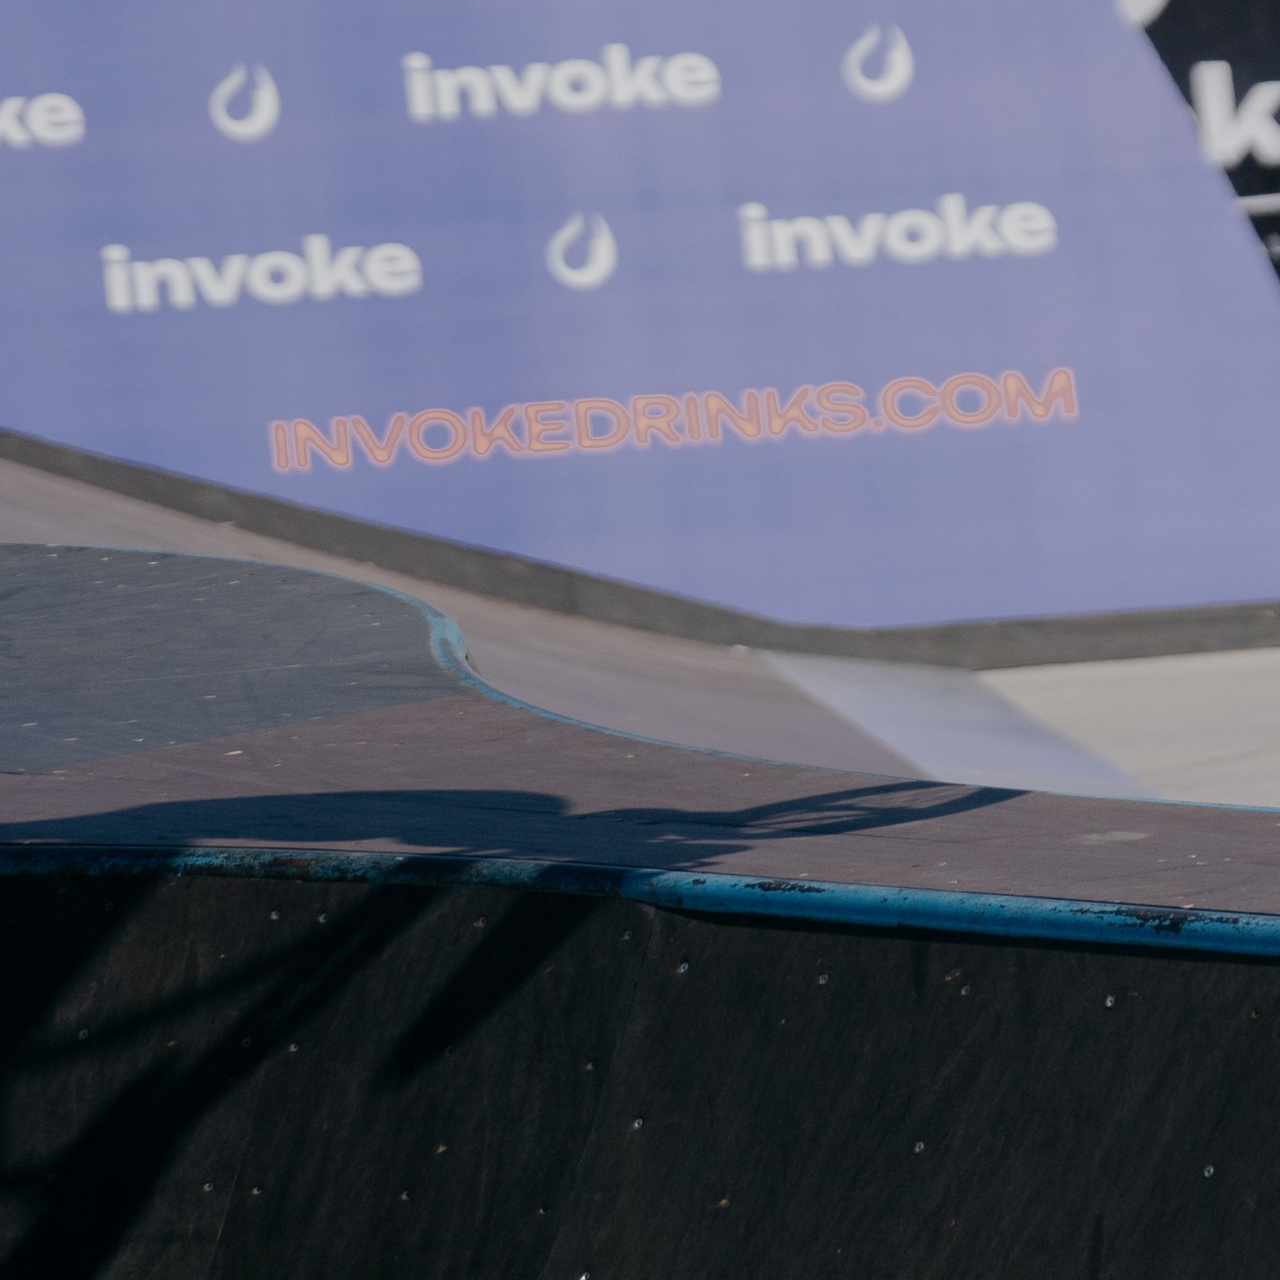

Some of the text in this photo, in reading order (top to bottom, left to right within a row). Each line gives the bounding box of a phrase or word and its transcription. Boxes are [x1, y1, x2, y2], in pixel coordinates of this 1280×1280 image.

[402, 42, 722, 124] invoke
[738, 192, 1058, 272] invoke
[100, 233, 423, 314] invoke
[268, 365, 1081, 474] INVOKEDRINKS.COM
